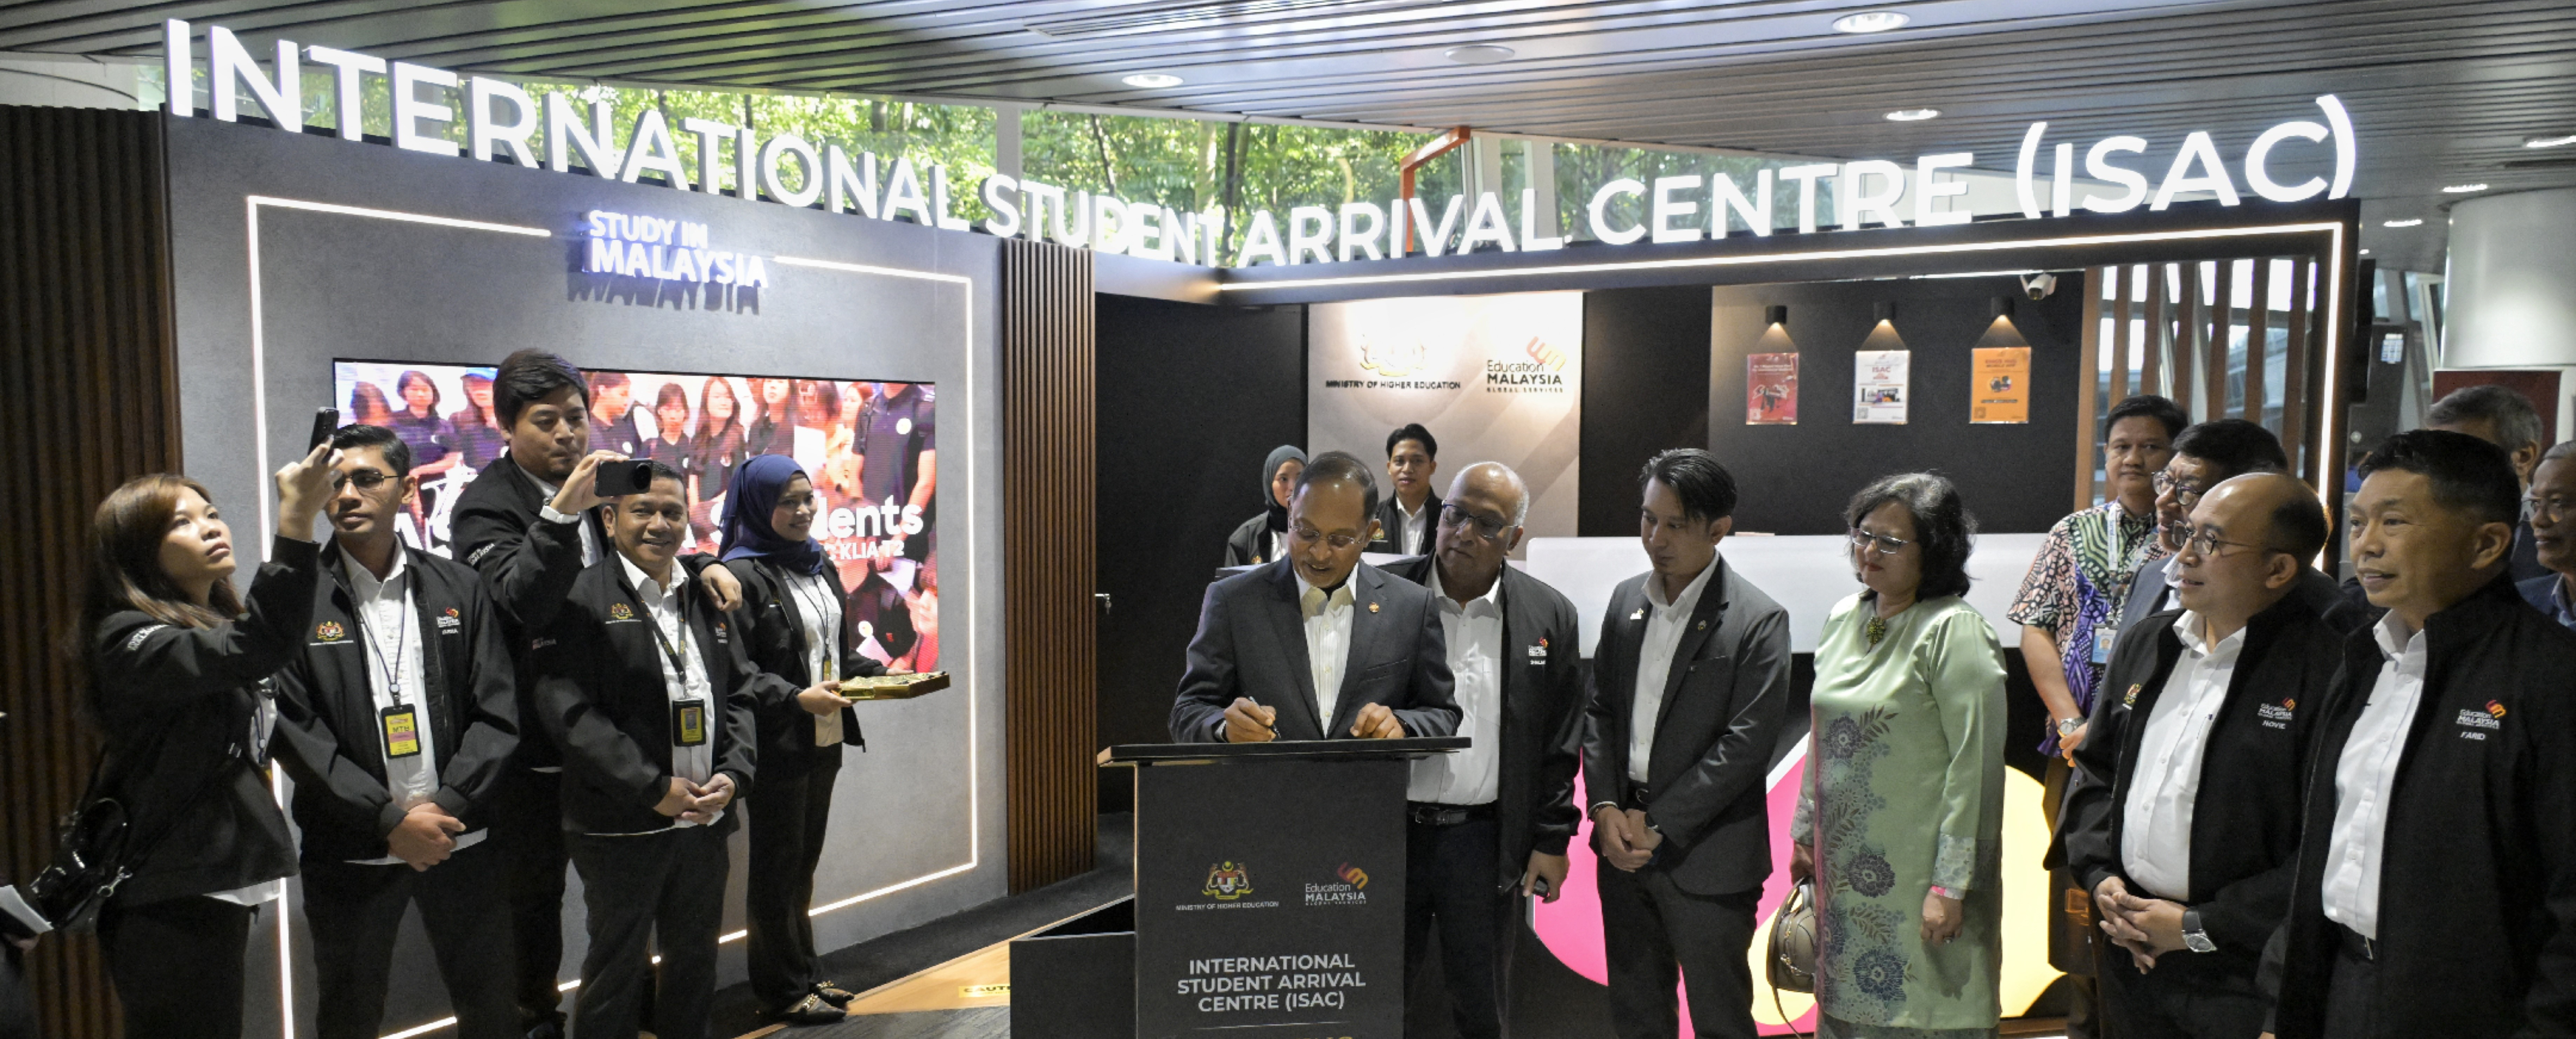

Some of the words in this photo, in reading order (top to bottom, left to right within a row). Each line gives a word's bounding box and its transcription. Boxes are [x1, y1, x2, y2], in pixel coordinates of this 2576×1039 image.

[162, 18, 970, 233] INTERNATIONAL
[978, 173, 1224, 268] STUDENT
[1237, 188, 1564, 268] ARRIVAL
[1589, 152, 1974, 245] CENTRE
[2016, 94, 2356, 220] (ISAC)
[589, 210, 676, 245] STUDY
[681, 221, 708, 249] IN
[591, 237, 769, 288] MALAYSIA
[1487, 359, 1544, 372] Education
[1326, 380, 1364, 388] MINISTRY
[1380, 381, 1411, 389] HIGHER
[1414, 381, 1461, 390] EDUCATION
[1487, 373, 1562, 385] MALAYSIA
[840, 541, 879, 560] KLIA
[881, 540, 905, 557] T2
[1305, 882, 1351, 893] Education
[1305, 891, 1366, 902] MALAYSIA
[1189, 953, 1355, 975] INTERNATIONAL
[1177, 975, 1273, 994] STUDENT
[1277, 971, 1366, 990] ARRIVAL
[1198, 994, 1279, 1012] CENTRE
[1285, 991, 1345, 1012] (ISAC)
